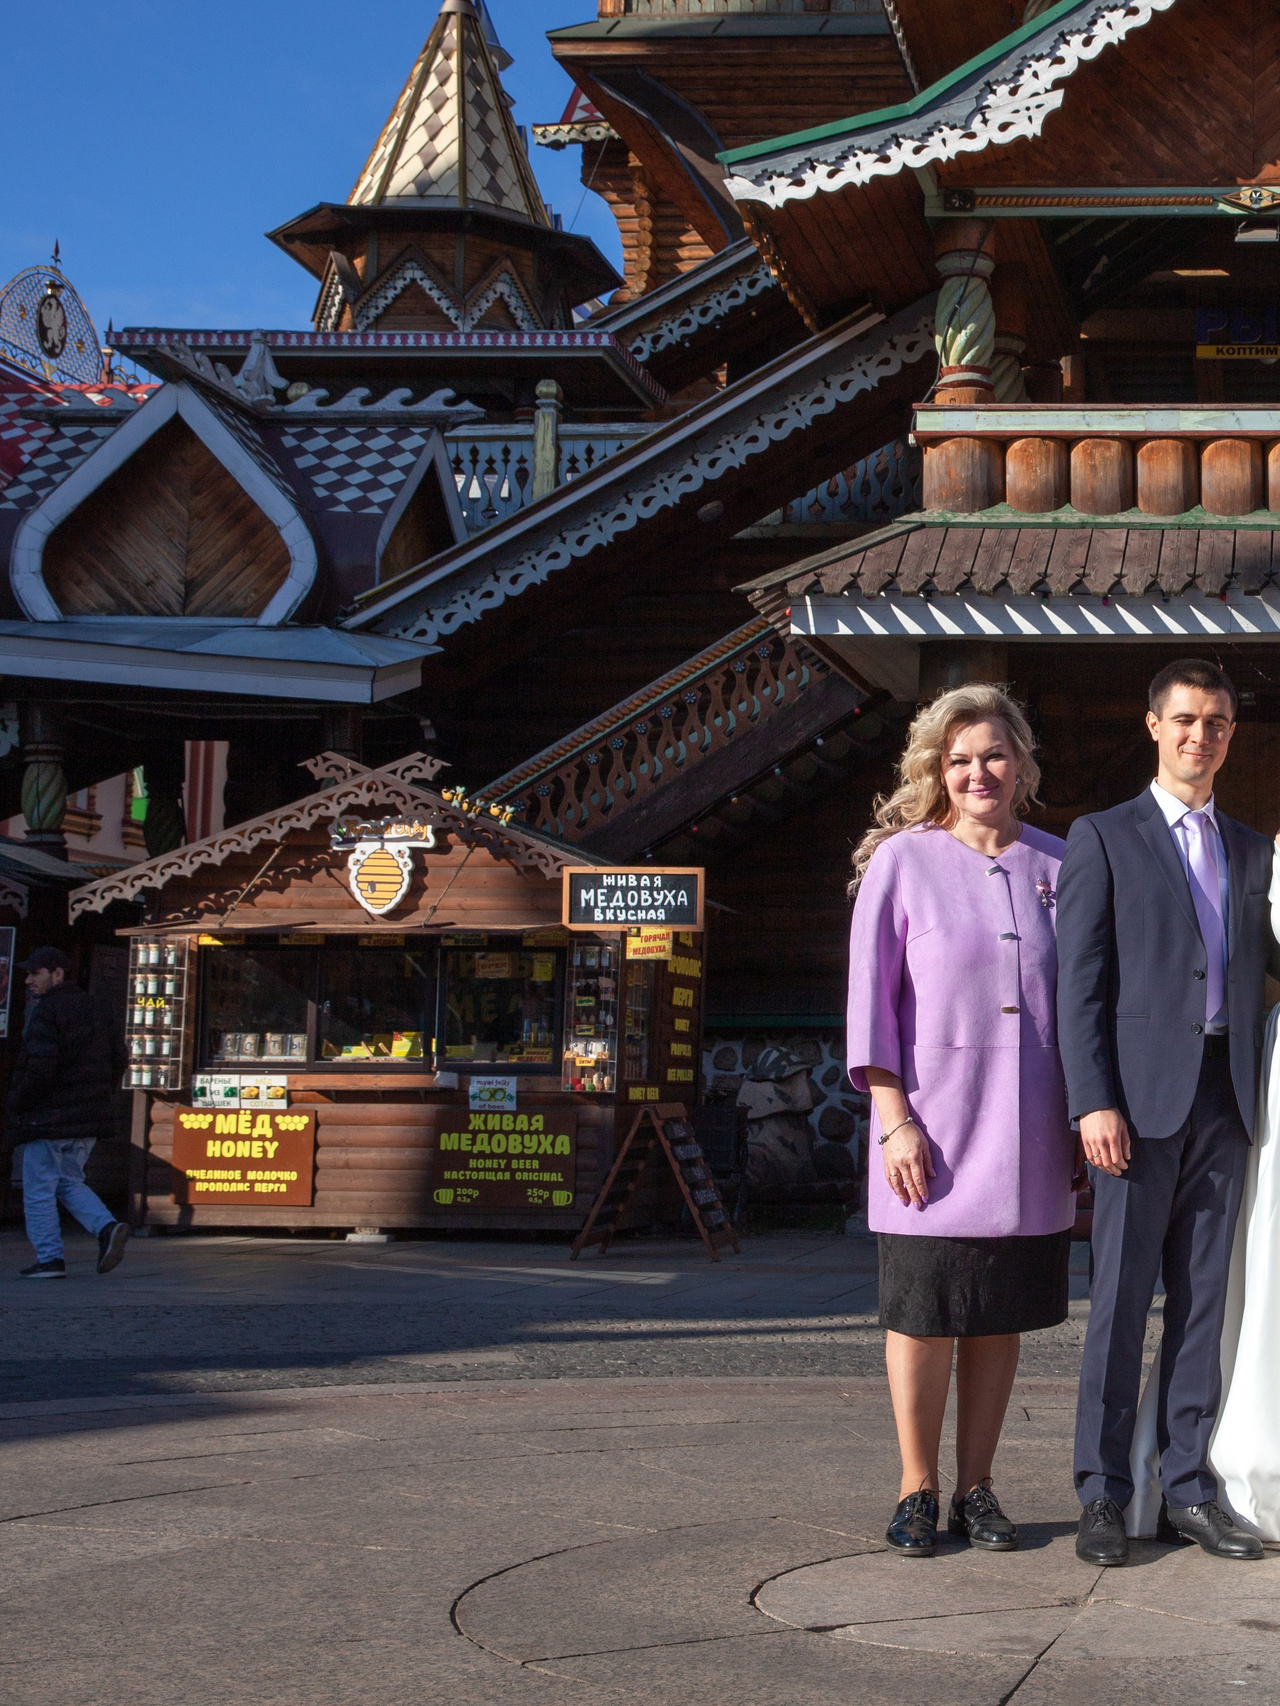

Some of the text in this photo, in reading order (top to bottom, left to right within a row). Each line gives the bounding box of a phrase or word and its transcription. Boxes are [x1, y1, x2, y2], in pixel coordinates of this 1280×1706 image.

[1216, 346, 1279, 356] КОПТИМ
[602, 874, 662, 888] ЖИВАЯ
[580, 888, 688, 908] МЕДОВУХА
[594, 908, 666, 921] ВКУСНАЯ
[632, 945, 667, 956] МЕДОВУХА
[136, 997, 165, 1009] ЧАЙ
[200, 1077, 232, 1085] ВАРЕНЬЕ
[214, 1109, 273, 1138] МЁД
[467, 1113, 544, 1132] ЖИВАЯ
[206, 1140, 279, 1159] HONEY
[439, 1132, 571, 1155] МЕДОВУХА
[468, 1158, 540, 1169] HONEY BEER
[185, 1169, 298, 1181] ПЧЕЛИНОЕ МОЛОЧКО
[443, 1170, 564, 1182] НАСТОЯЩАЯ ORIGINAL
[195, 1181, 287, 1193] ПРОПОЛИС ПЕРГА
